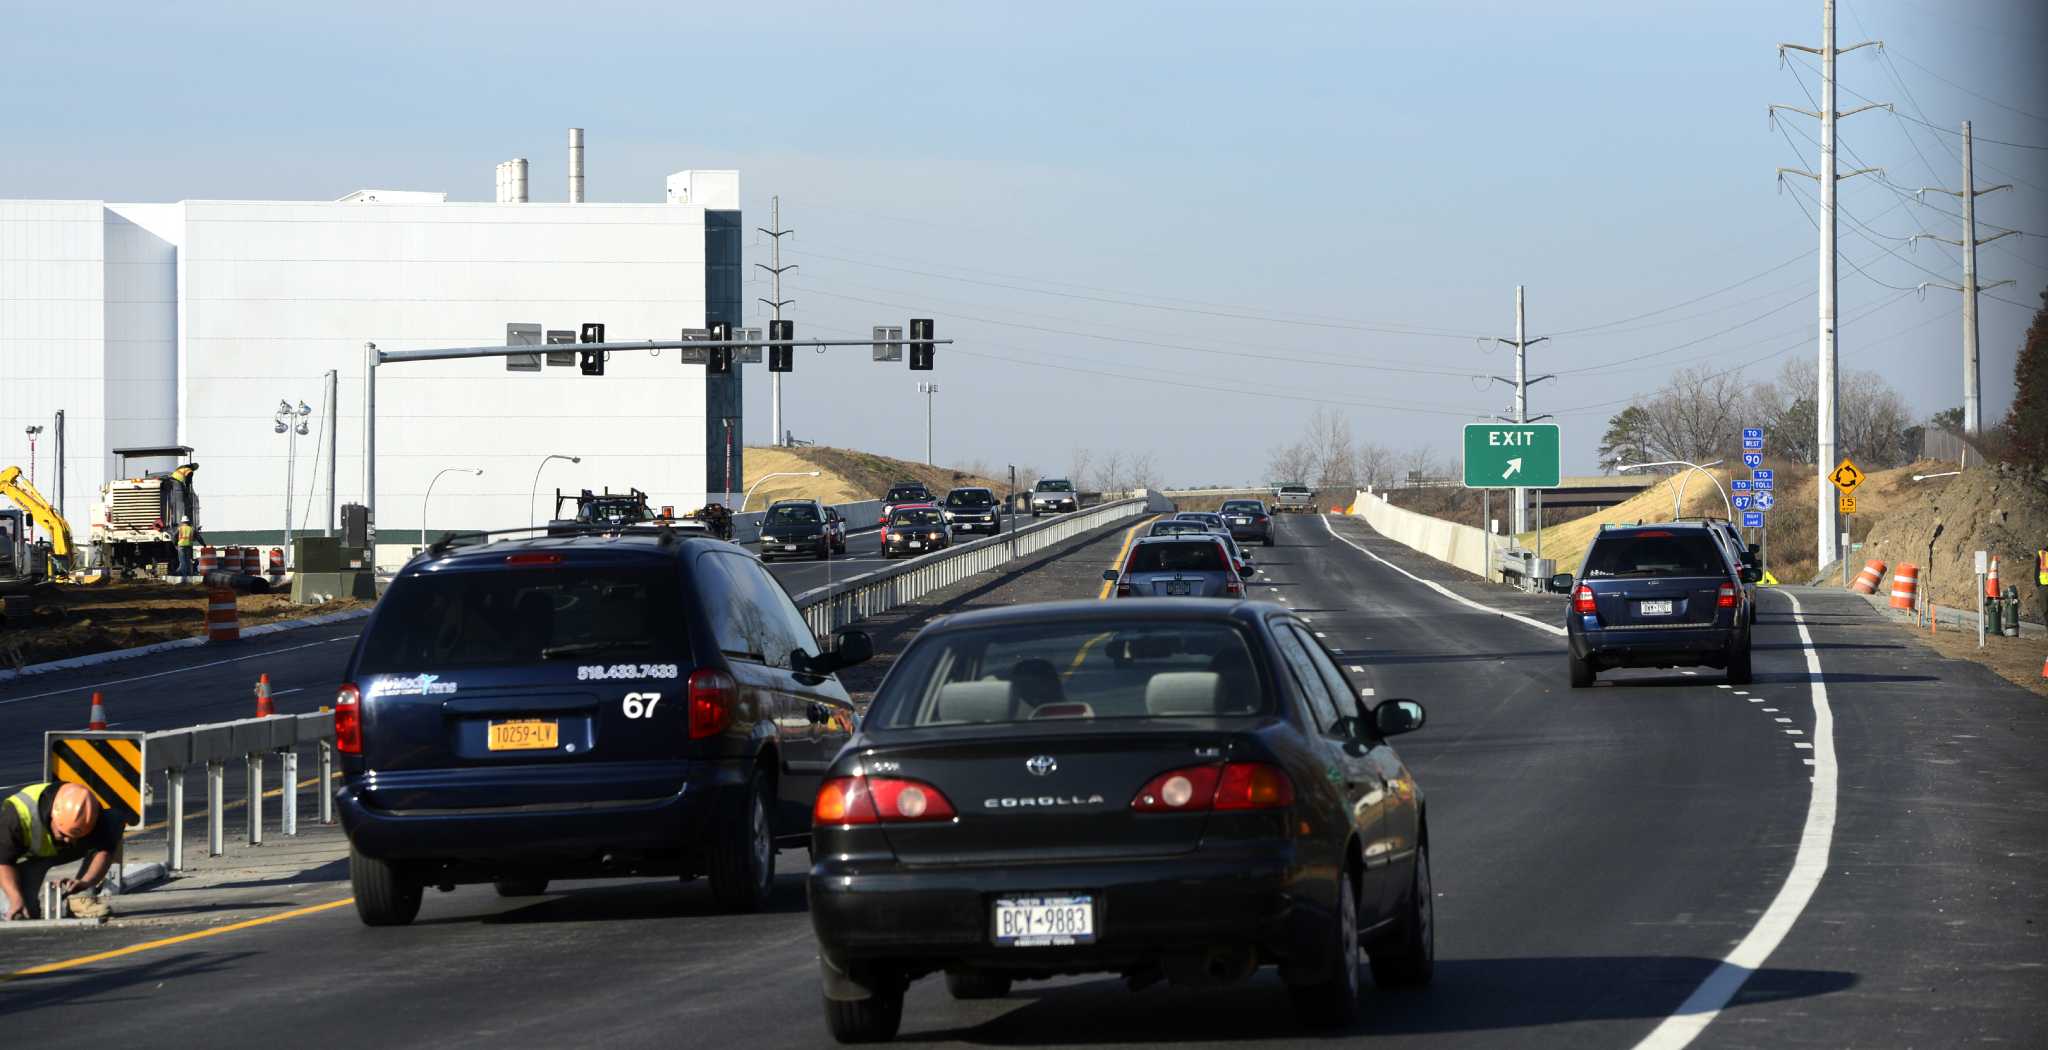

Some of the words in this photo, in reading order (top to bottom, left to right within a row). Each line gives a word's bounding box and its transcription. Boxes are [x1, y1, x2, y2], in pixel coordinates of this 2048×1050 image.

[1488, 431, 1535, 446] EXIT
[1745, 440, 1761, 448] WEST
[1745, 455, 1760, 465] 90
[1758, 471, 1768, 479] TO
[1755, 481, 1771, 489] TOLL
[1735, 497, 1749, 508] 87
[1841, 498, 1854, 507] 15
[577, 664, 678, 680] 518.433.7433
[622, 691, 661, 719] 67
[984, 794, 1104, 808] COROLLA
